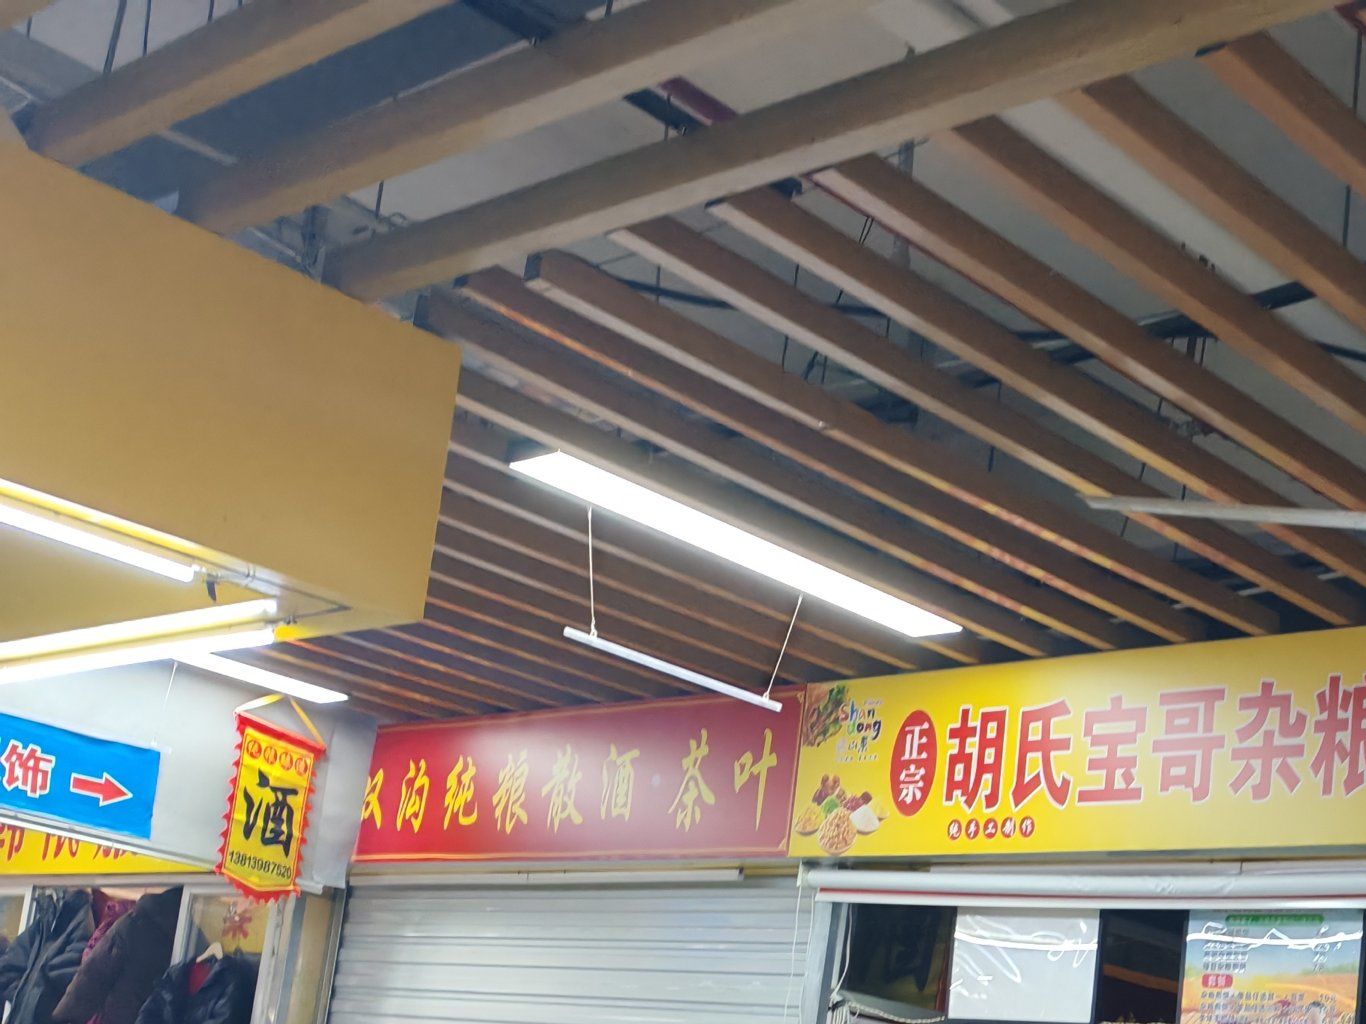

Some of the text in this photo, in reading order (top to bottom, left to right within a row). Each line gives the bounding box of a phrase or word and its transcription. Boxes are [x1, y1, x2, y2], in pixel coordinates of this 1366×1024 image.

[899, 721, 930, 804] 正宗
[243, 768, 299, 858] 酒
[948, 815, 1035, 841] 纯手工制作
